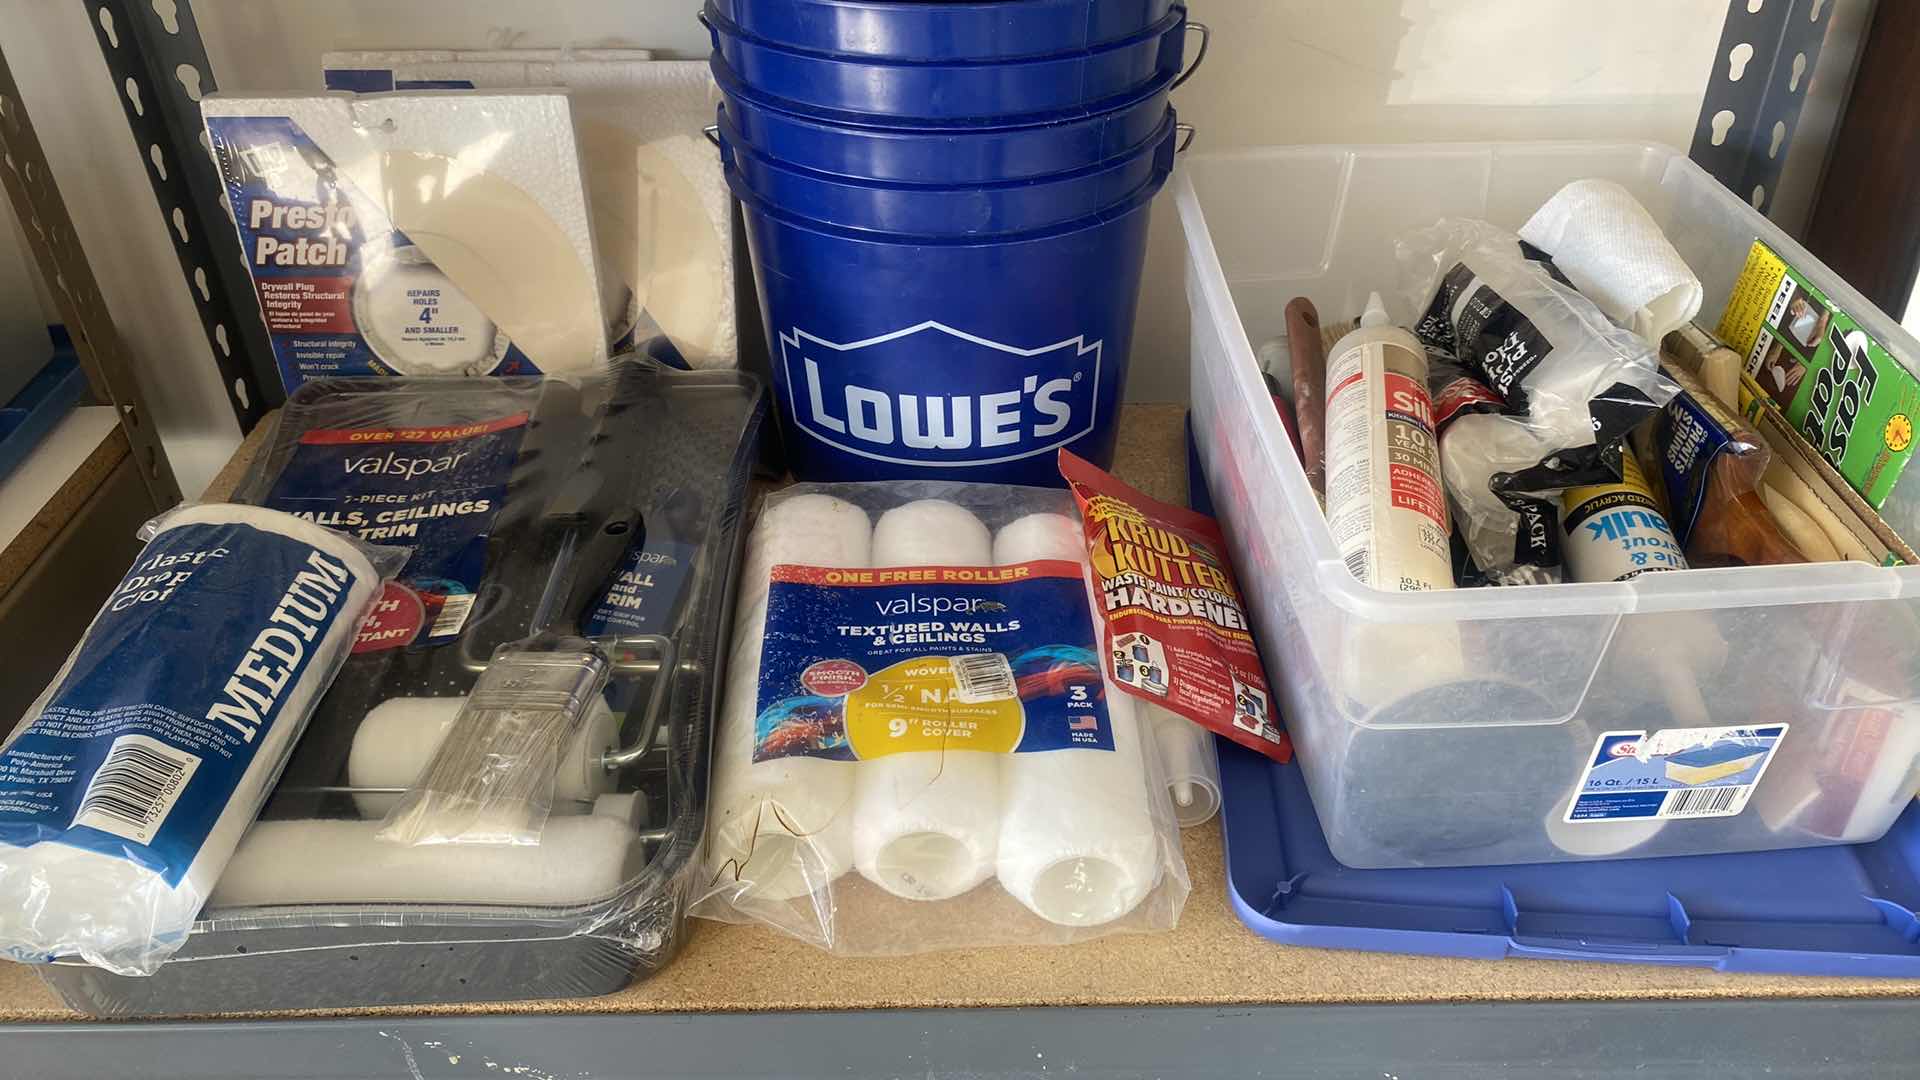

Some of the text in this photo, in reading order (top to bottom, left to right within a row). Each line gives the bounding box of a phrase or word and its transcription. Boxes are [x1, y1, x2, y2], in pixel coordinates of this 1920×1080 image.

[251, 199, 352, 229] Presto
[256, 236, 347, 266] Patch
[262, 283, 314, 291] Drywall Plug
[267, 301, 301, 309] Integrity
[1769, 279, 1792, 322] PEEL
[419, 307, 438, 324] 4"
[1746, 332, 1768, 375] STICK
[804, 357, 1073, 449] LOWE'S
[351, 432, 394, 441] OVER
[430, 425, 489, 440] VALUE!
[1395, 425, 1425, 447] 10
[1666, 410, 1694, 463] STAINS
[1674, 420, 1704, 475] PAINTS
[1394, 452, 1410, 461] 30
[344, 451, 470, 481] valspar
[344, 490, 437, 504] 7-PIECE KIT
[1584, 494, 1626, 514] ACRYLIC
[376, 500, 490, 523] CEILINGS
[358, 524, 418, 541] TRIM
[1106, 515, 1190, 558] KRUD
[1631, 551, 1648, 566] &
[825, 566, 1029, 584] ONE FREE ROLLER
[1112, 543, 1236, 598] KUTTER
[611, 583, 638, 594] and
[1102, 573, 1147, 592] WASTE
[1400, 577, 1421, 587] 10.1
[876, 593, 983, 616] valspar
[837, 620, 1021, 637] TEXTURED WALLS
[873, 632, 987, 646] & CEILINGS
[206, 551, 350, 745] MEDIUM
[1070, 686, 1088, 700] 3
[1067, 701, 1094, 709] PACK
[39, 729, 61, 737] THEM
[69, 707, 91, 716] BAGS
[154, 704, 178, 718] CAUSE
[224, 734, 242, 747] KEEP
[165, 715, 185, 728] FROM
[185, 723, 212, 739] BABIES
[212, 735, 227, 746] AND
[922, 719, 978, 730] ROLLER
[922, 727, 972, 738] COVER
[46, 721, 61, 729] NOT
[152, 717, 175, 730] WITH
[194, 733, 209, 746] AND
[209, 741, 220, 752] DO
[219, 746, 233, 759] NOT
[7, 750, 61, 761] Manufactured
[10, 758, 63, 769] Poly-America
[20, 767, 55, 776] Marshall
[164, 769, 186, 796] 00802
[1589, 779, 1601, 787] 16
[1605, 778, 1623, 787] Qt.
[1636, 777, 1651, 785] 15
